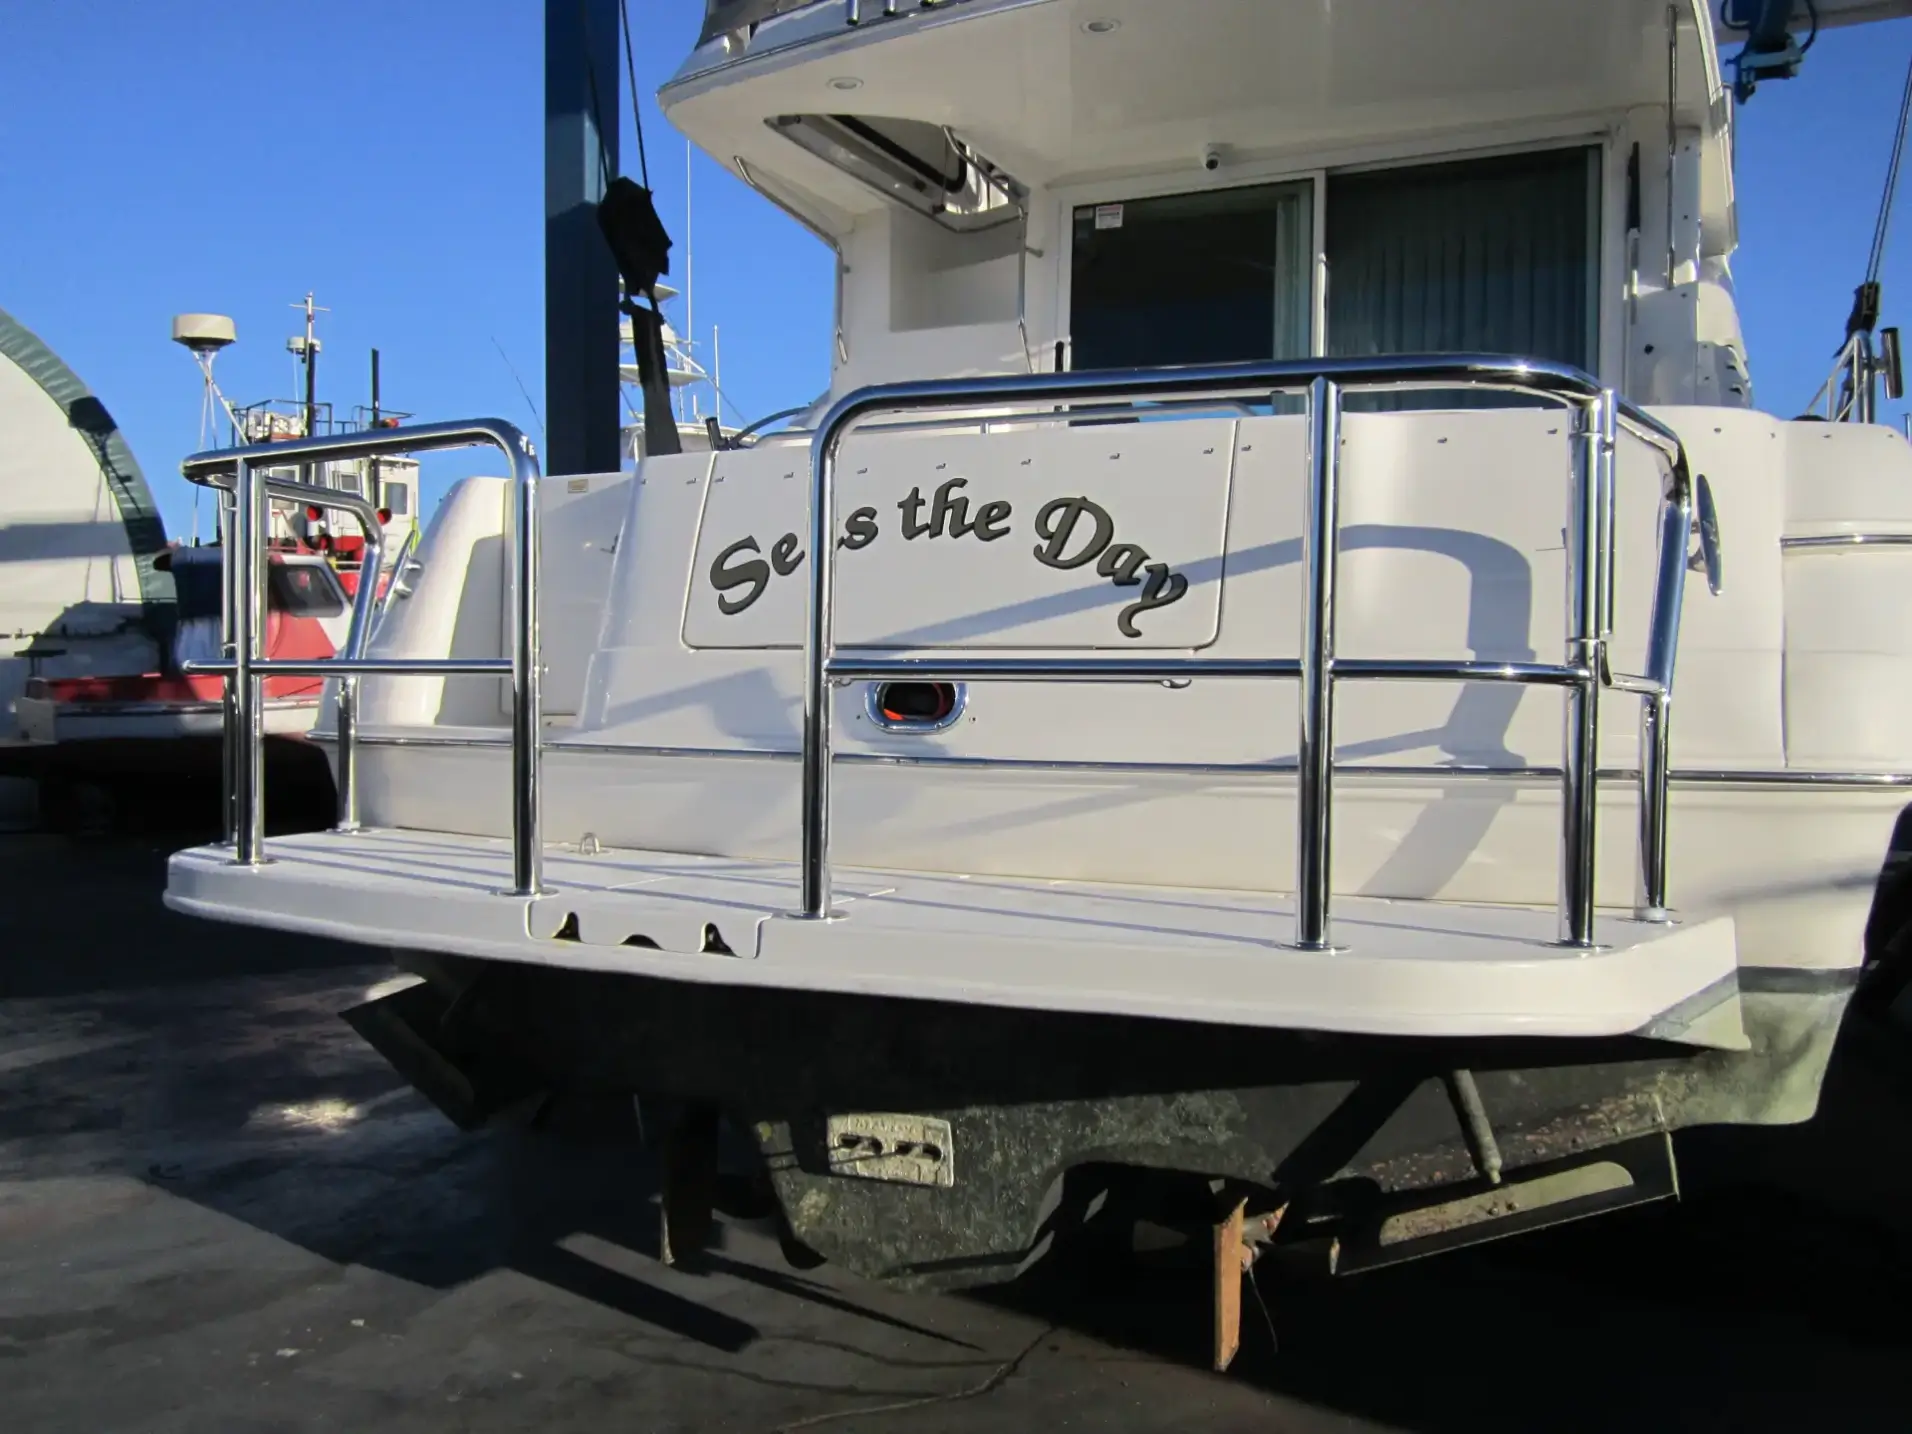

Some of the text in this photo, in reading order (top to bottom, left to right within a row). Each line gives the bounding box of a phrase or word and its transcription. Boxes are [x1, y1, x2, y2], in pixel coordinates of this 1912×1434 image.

[709, 477, 1189, 639] Ses the Day
